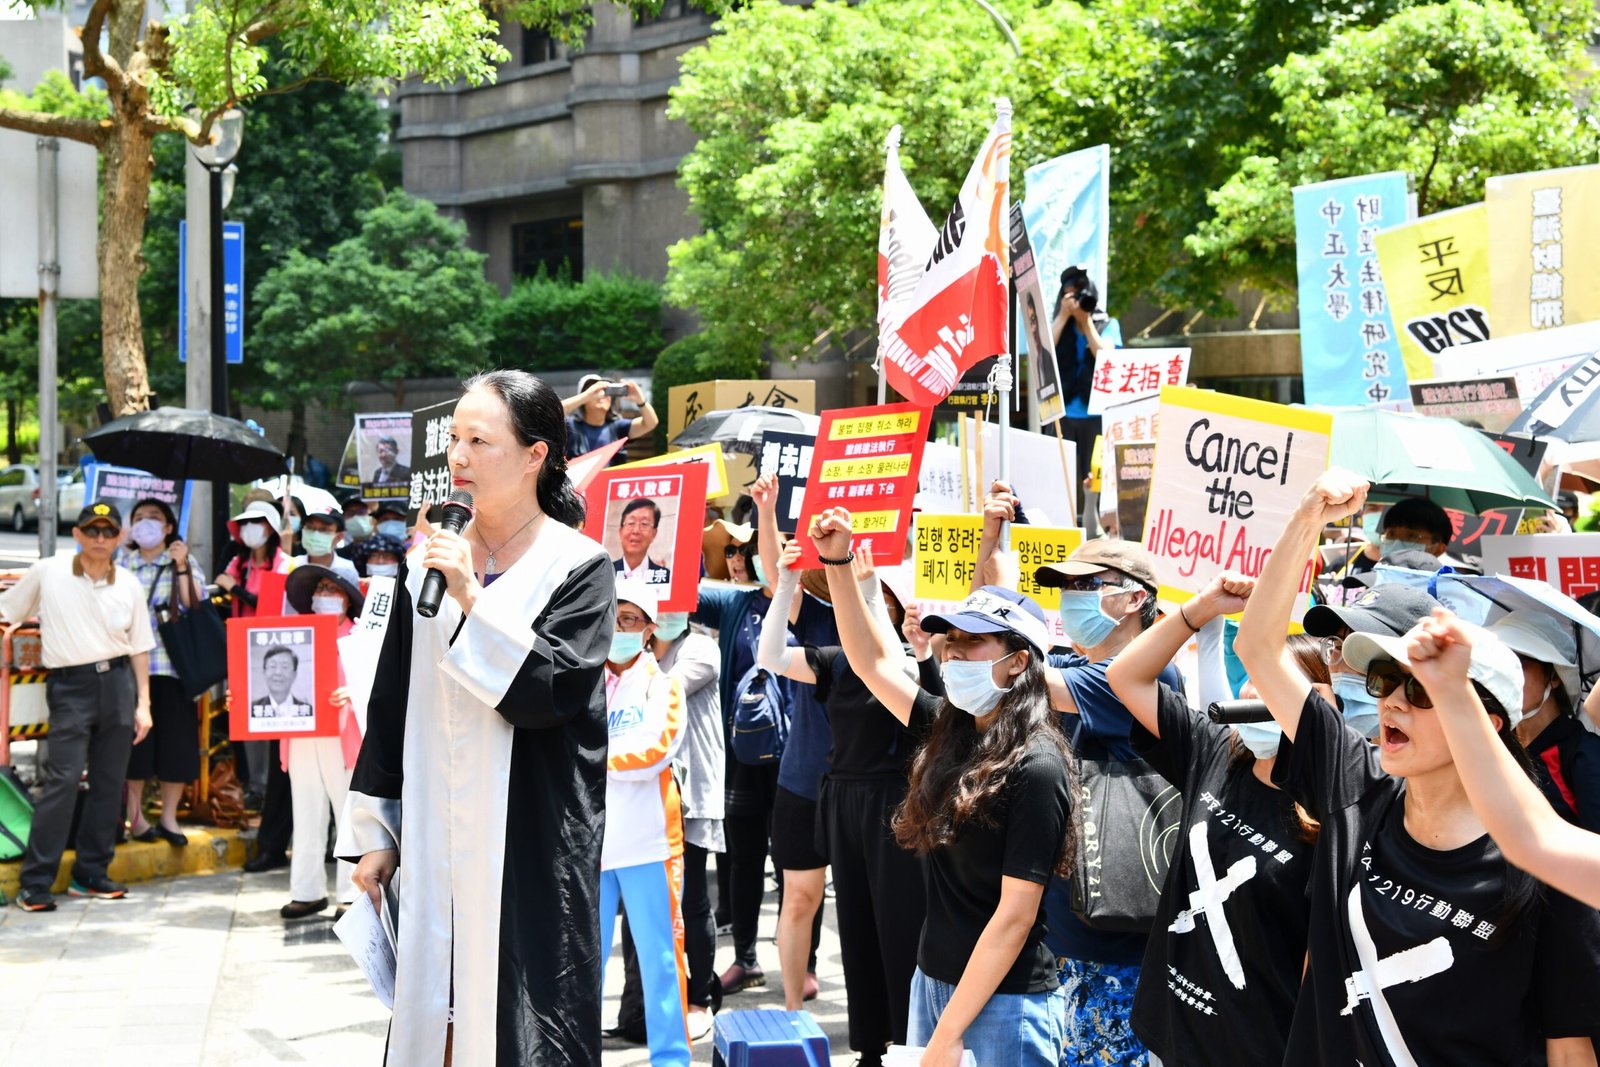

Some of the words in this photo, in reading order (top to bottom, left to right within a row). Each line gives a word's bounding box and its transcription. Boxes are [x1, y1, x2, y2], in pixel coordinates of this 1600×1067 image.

[1093, 354, 1184, 394] 違法拍賣
[1185, 418, 1294, 486] Cancel
[1205, 477, 1255, 519] the
[917, 527, 943, 553] 집행
[1019, 540, 1067, 564] 양심으로
[1148, 509, 1227, 577] illegal
[922, 559, 948, 585] 폐지
